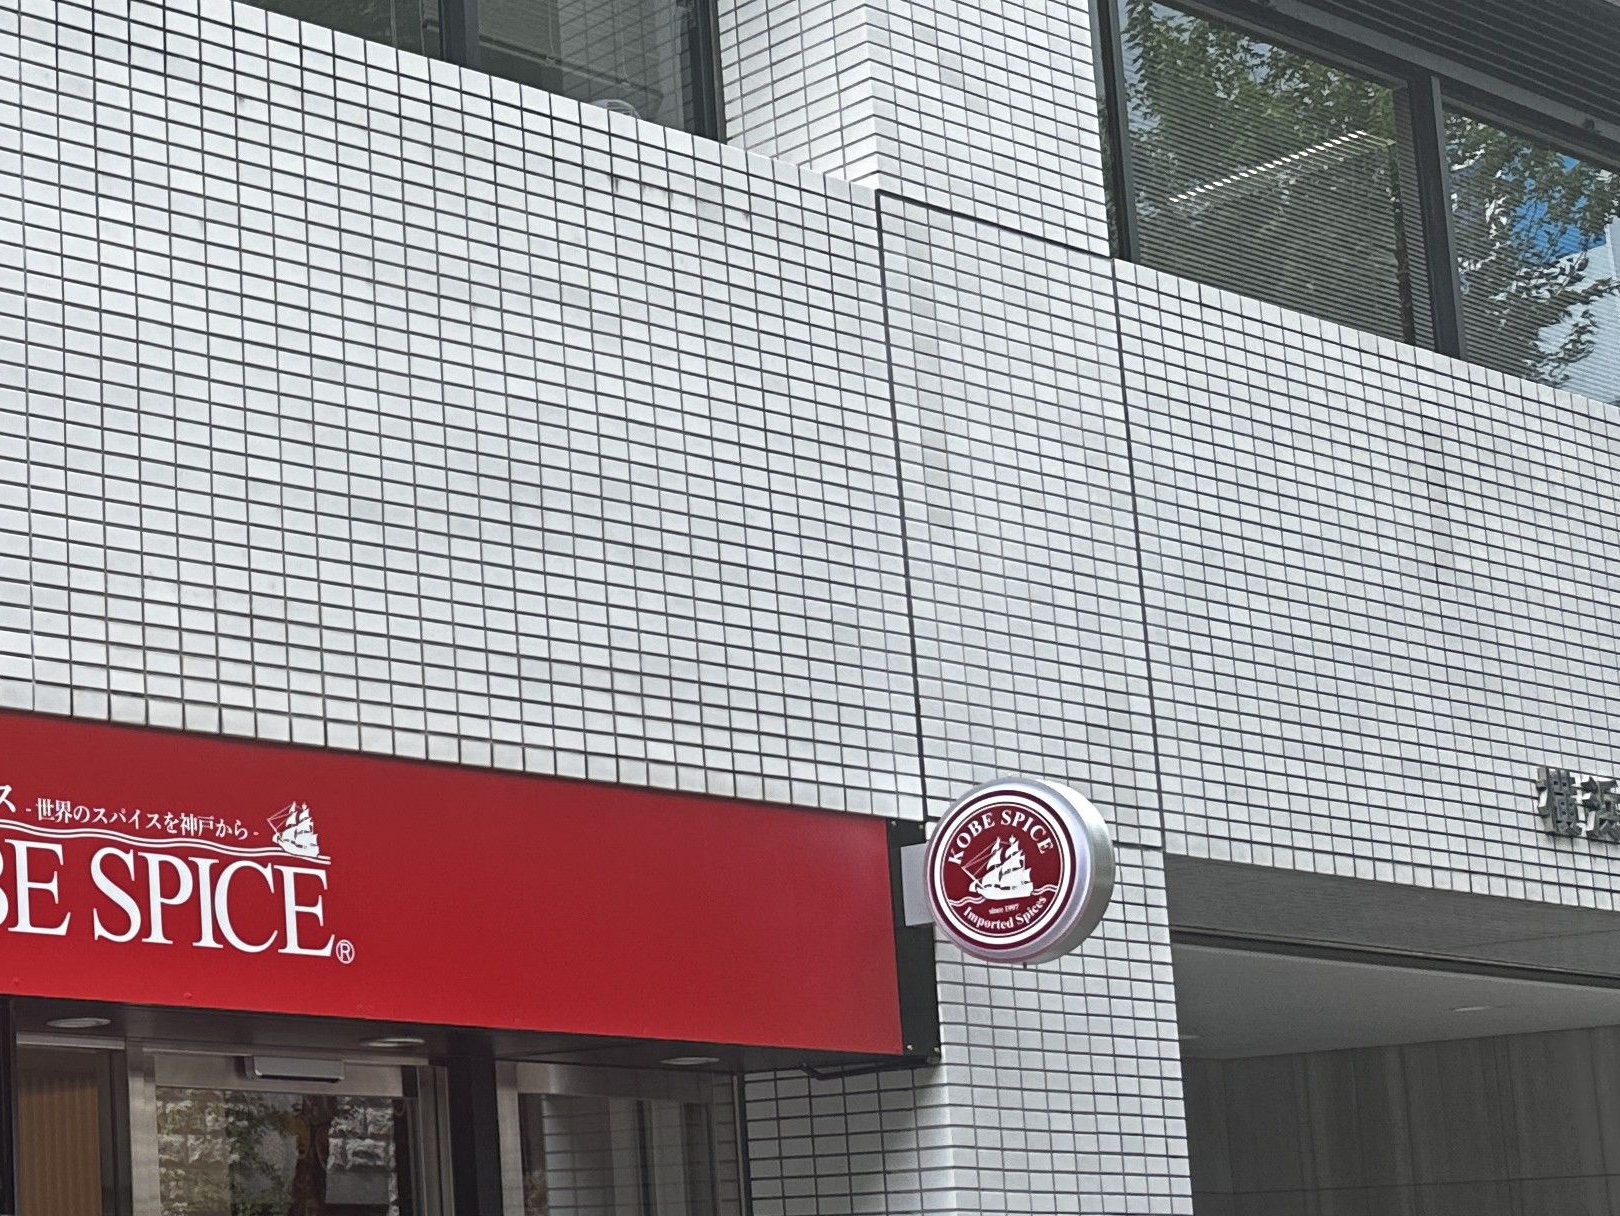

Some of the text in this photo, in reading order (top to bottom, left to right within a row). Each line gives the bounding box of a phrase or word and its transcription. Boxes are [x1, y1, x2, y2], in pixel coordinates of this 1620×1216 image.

[948, 809, 1054, 865] KOBE SPICE
[90, 847, 335, 957] SPICE
[963, 896, 1047, 929] Imported Spices
